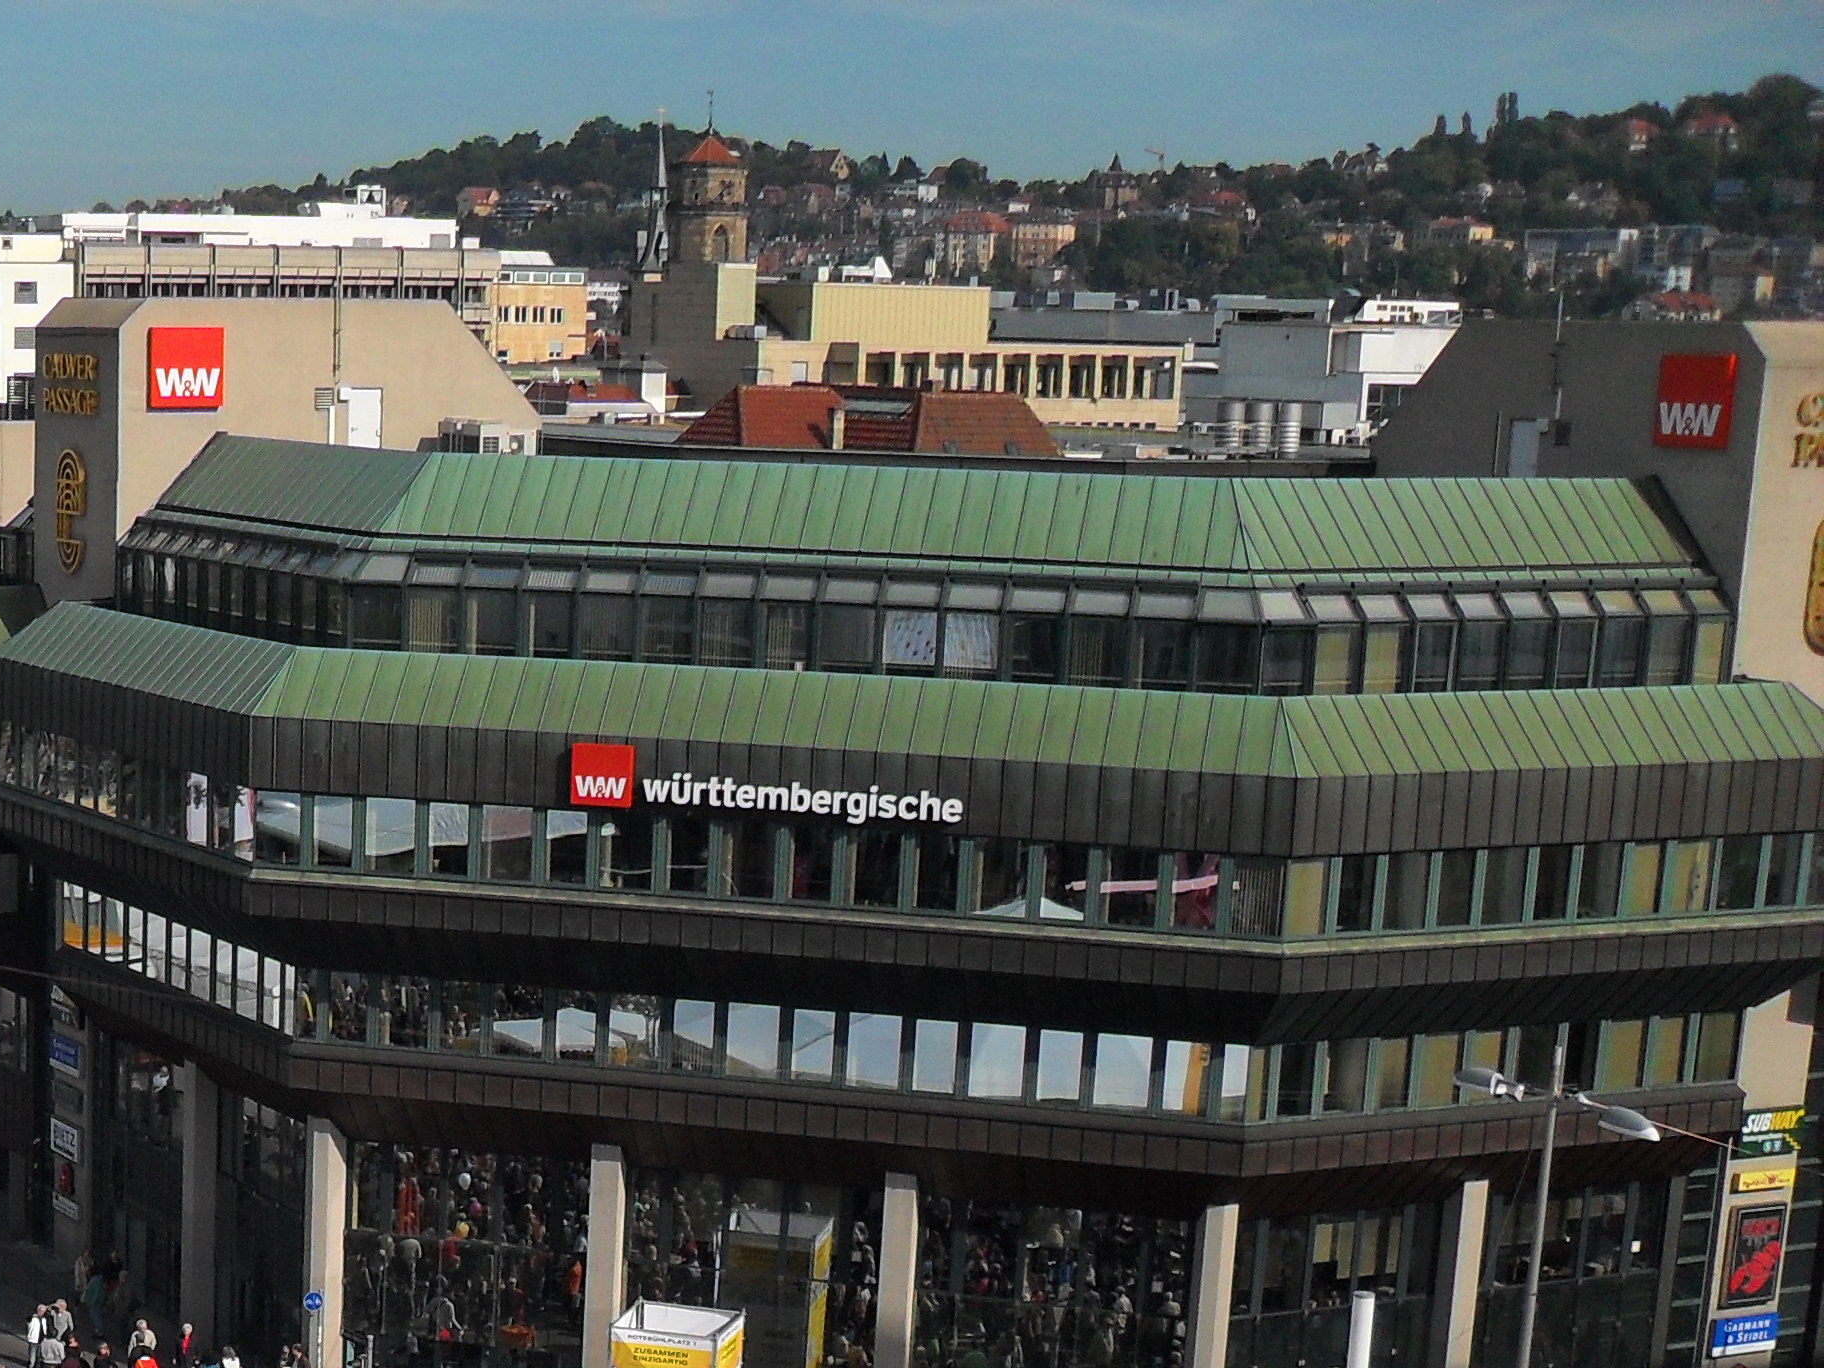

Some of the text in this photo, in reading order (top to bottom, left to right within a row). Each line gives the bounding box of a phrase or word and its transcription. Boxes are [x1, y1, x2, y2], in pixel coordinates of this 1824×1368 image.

[42, 352, 96, 381] CALWER
[42, 386, 97, 415] PASSAGE
[642, 772, 964, 825] württembergische
[1741, 1108, 1806, 1134] SUBWAY
[633, 1346, 689, 1359] ZUSAMMEN
